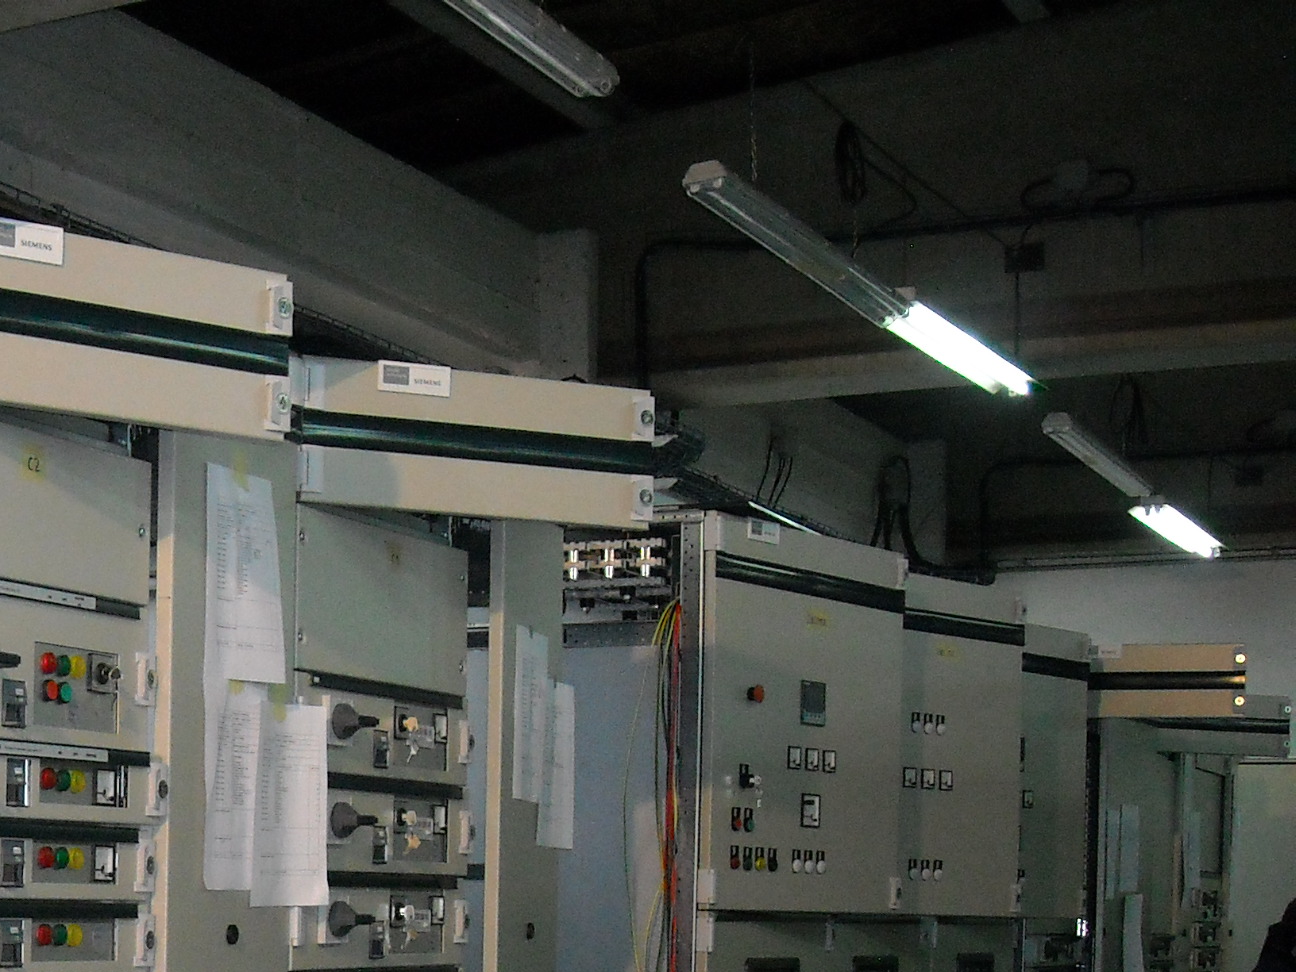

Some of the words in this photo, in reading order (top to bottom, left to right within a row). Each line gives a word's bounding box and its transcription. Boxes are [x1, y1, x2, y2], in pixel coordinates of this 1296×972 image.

[20, 239, 53, 251] SIEMENS
[413, 378, 442, 386] SIEMENS
[27, 456, 41, 473] C2
